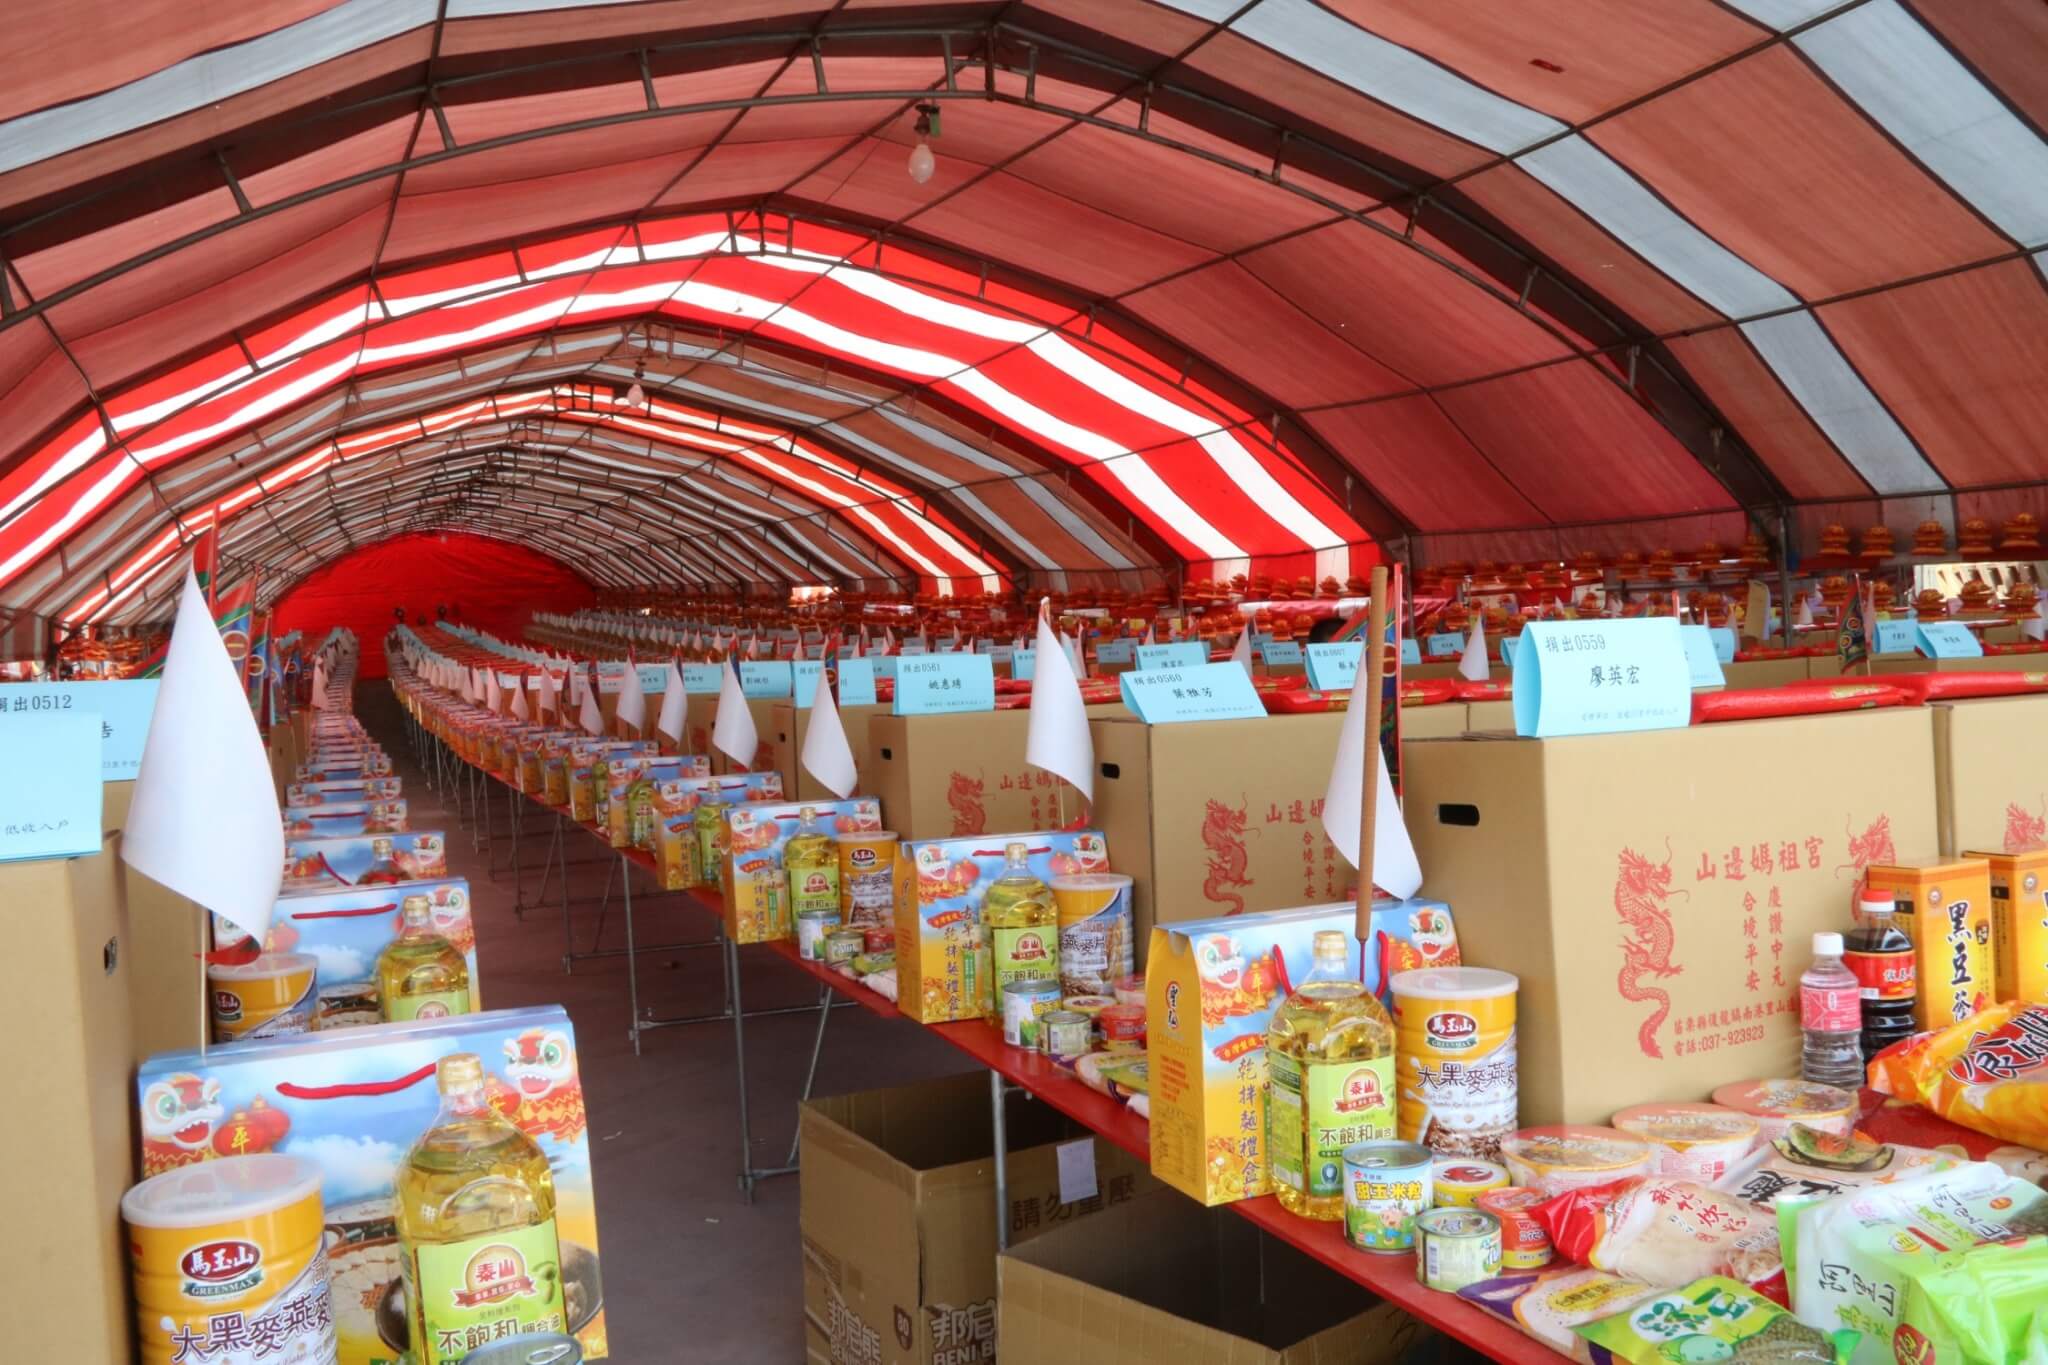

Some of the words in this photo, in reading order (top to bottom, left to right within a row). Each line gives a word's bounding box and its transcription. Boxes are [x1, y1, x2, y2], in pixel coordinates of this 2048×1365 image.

[1545, 633, 1607, 653] 捐出0559
[1589, 665, 1641, 687] 廖英宏
[1696, 836, 1824, 881] 山邊媽祖宮
[1742, 891, 1761, 992] 合境平安
[1432, 1016, 1473, 1034] 馬玉山
[1349, 1080, 1375, 1096] 泰山
[190, 1245, 255, 1277] 馬玉山
[474, 1258, 516, 1284] 泰山
[191, 1279, 255, 1298] GREENMAX
